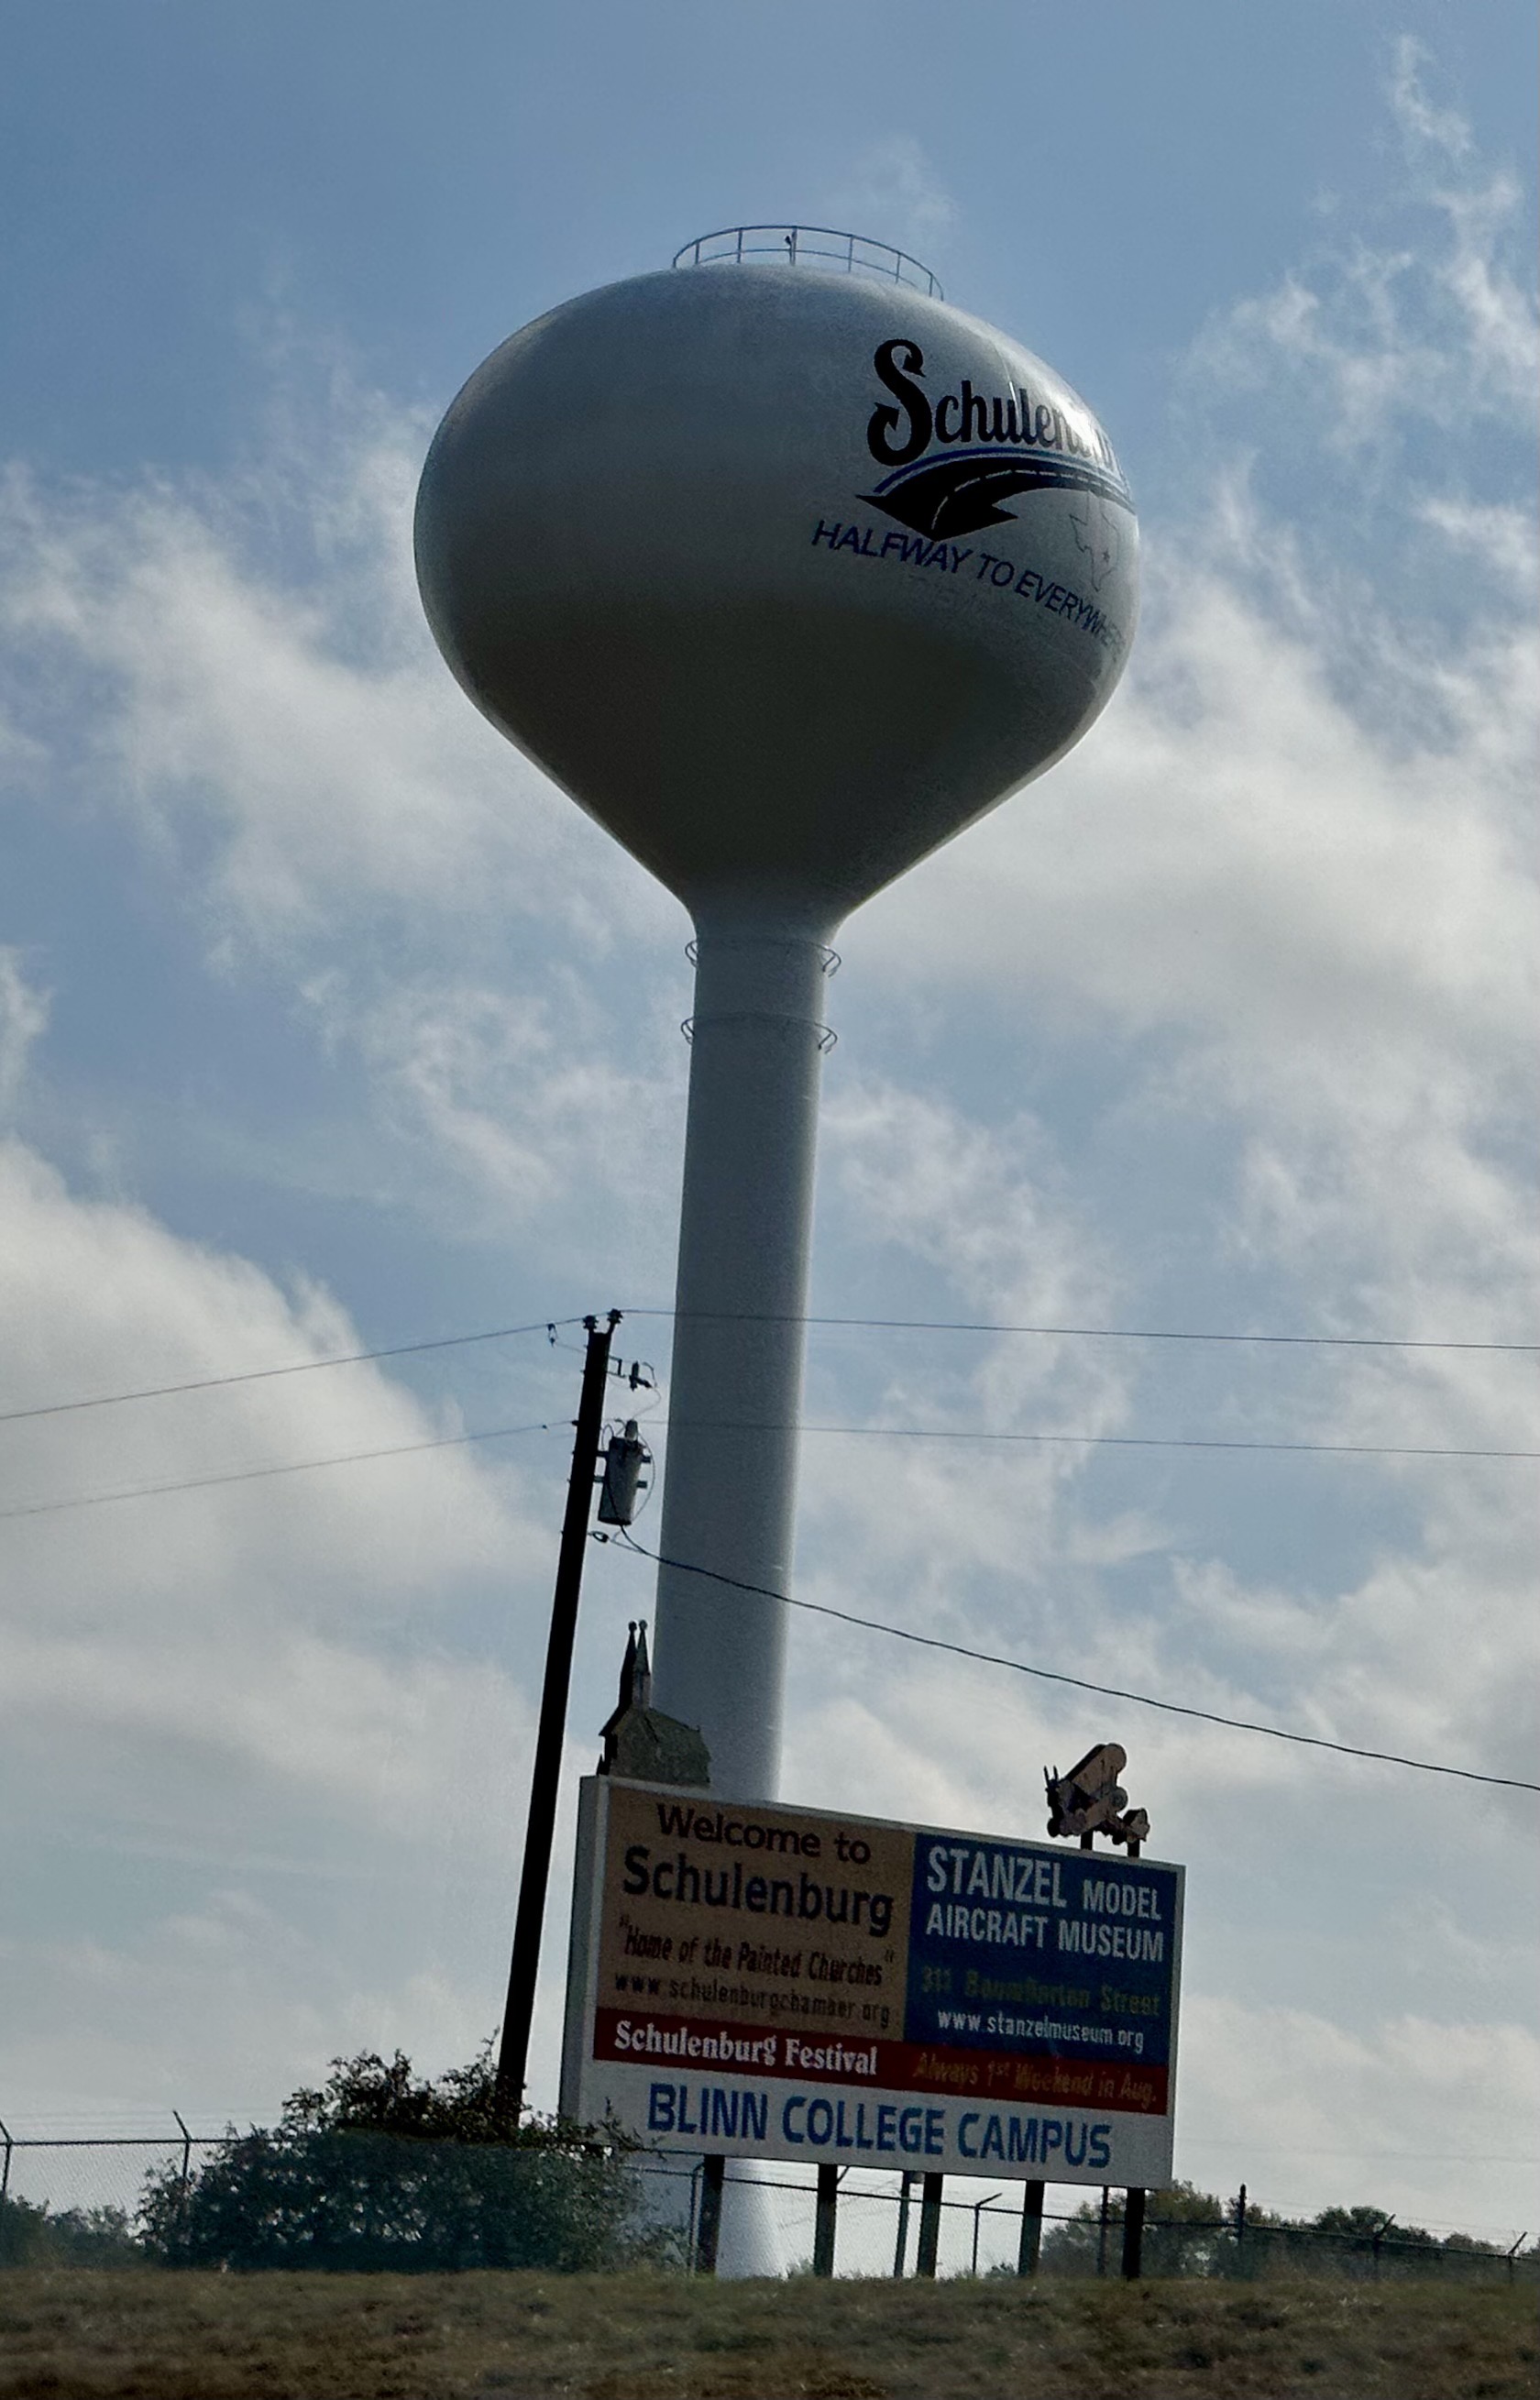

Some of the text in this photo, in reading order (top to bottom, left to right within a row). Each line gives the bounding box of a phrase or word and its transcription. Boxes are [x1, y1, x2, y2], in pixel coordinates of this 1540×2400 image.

[811, 520, 972, 575] HALFWAY
[976, 553, 1015, 588] TO
[656, 1804, 872, 1865] Welcome to
[623, 1844, 895, 1937] Schulenburg
[927, 1844, 1161, 1921] STANZEL MODEL
[678, 1937, 698, 1965] of
[704, 1937, 732, 1969] the
[737, 1941, 802, 1978] Painted
[926, 1903, 1164, 1963] AIRCRAFT MUSEUM
[1101, 1984, 1160, 2016] Street
[613, 2020, 877, 2075] Schulenburg Festival
[912, 2052, 980, 2091] Always
[1014, 2060, 1094, 2097] Weekend
[1098, 2069, 1116, 2098] in
[1117, 2072, 1157, 2108] Aug.
[647, 2082, 1111, 2169] BLINN COLLEGE CAMPUS
